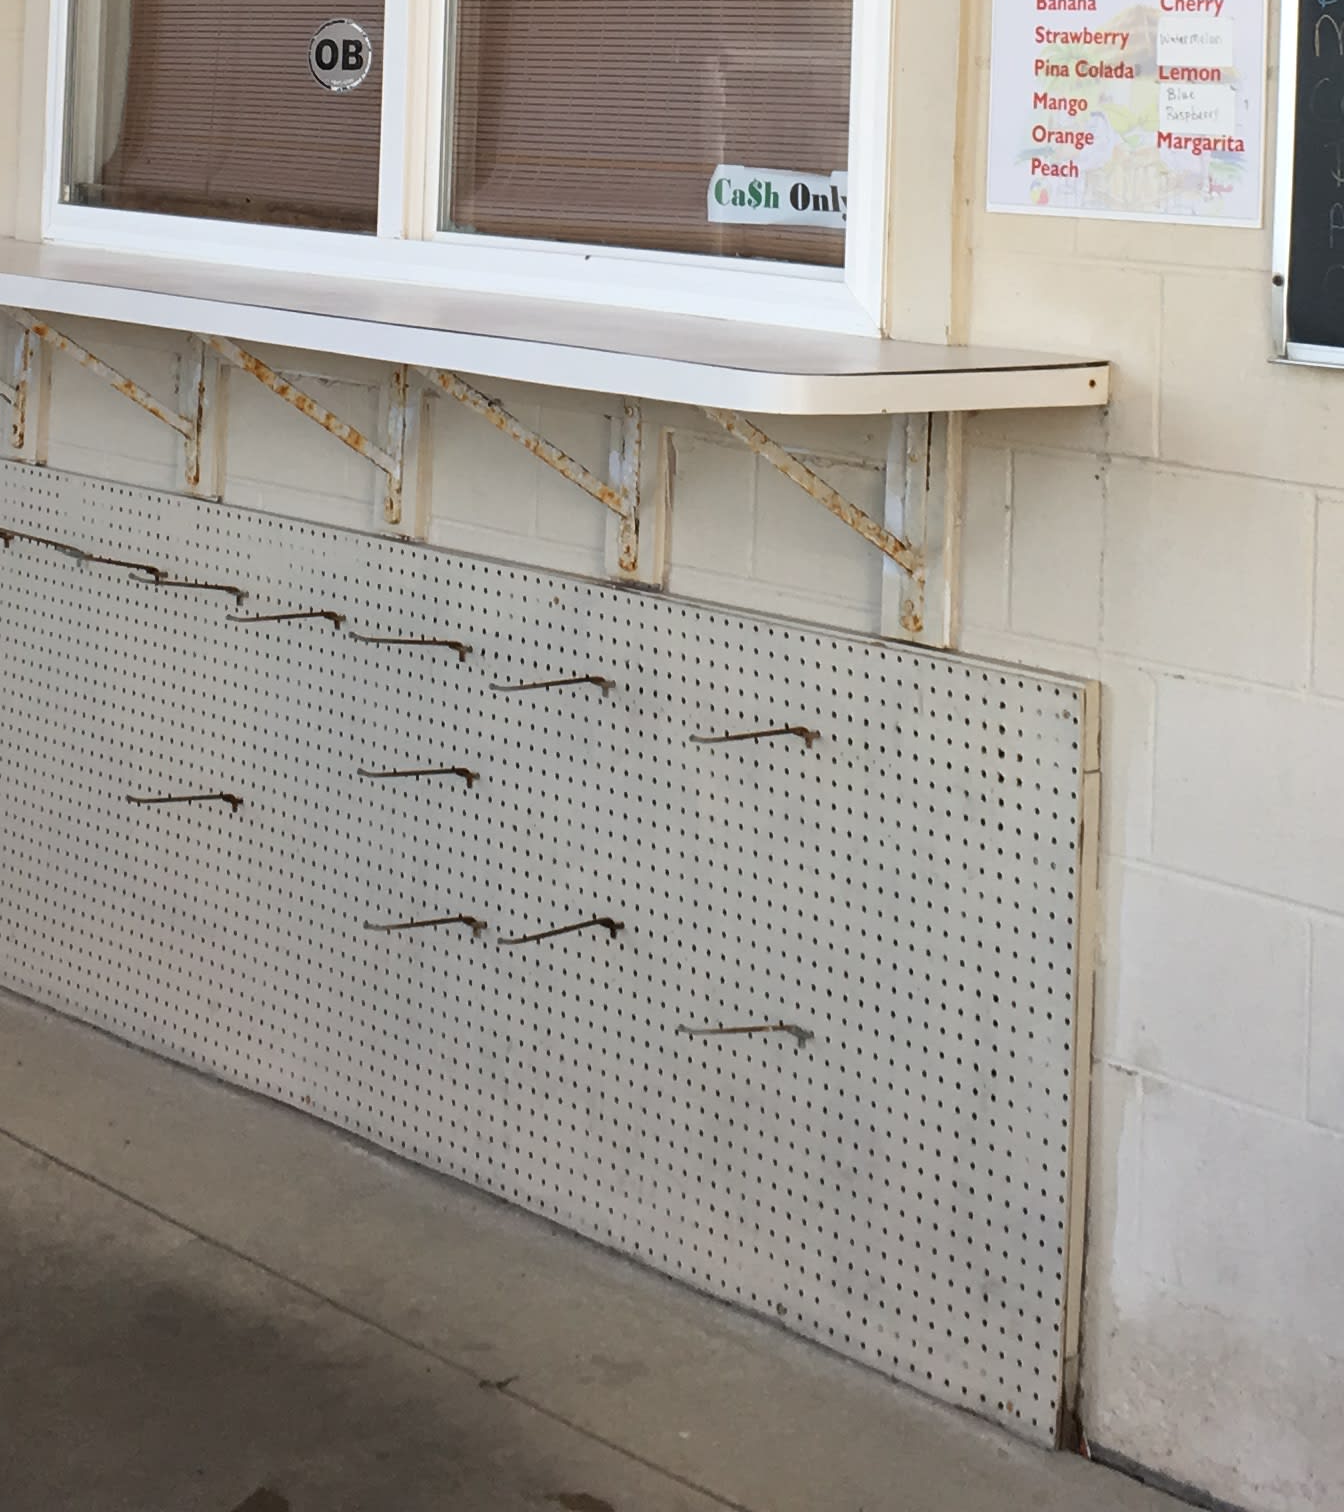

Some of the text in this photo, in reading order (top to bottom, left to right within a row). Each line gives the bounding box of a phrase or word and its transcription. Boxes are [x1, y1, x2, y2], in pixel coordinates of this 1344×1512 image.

[1035, 26, 1130, 49] Strawberry
[315, 39, 364, 71] OB
[1034, 59, 1135, 80] Pina Colada
[1158, 65, 1222, 81] Lemon
[1033, 93, 1089, 117] Mango
[1031, 125, 1095, 150] Orange
[1156, 131, 1246, 156] Margarita
[1031, 158, 1080, 178] Peach
[714, 178, 780, 212] Ca$h
